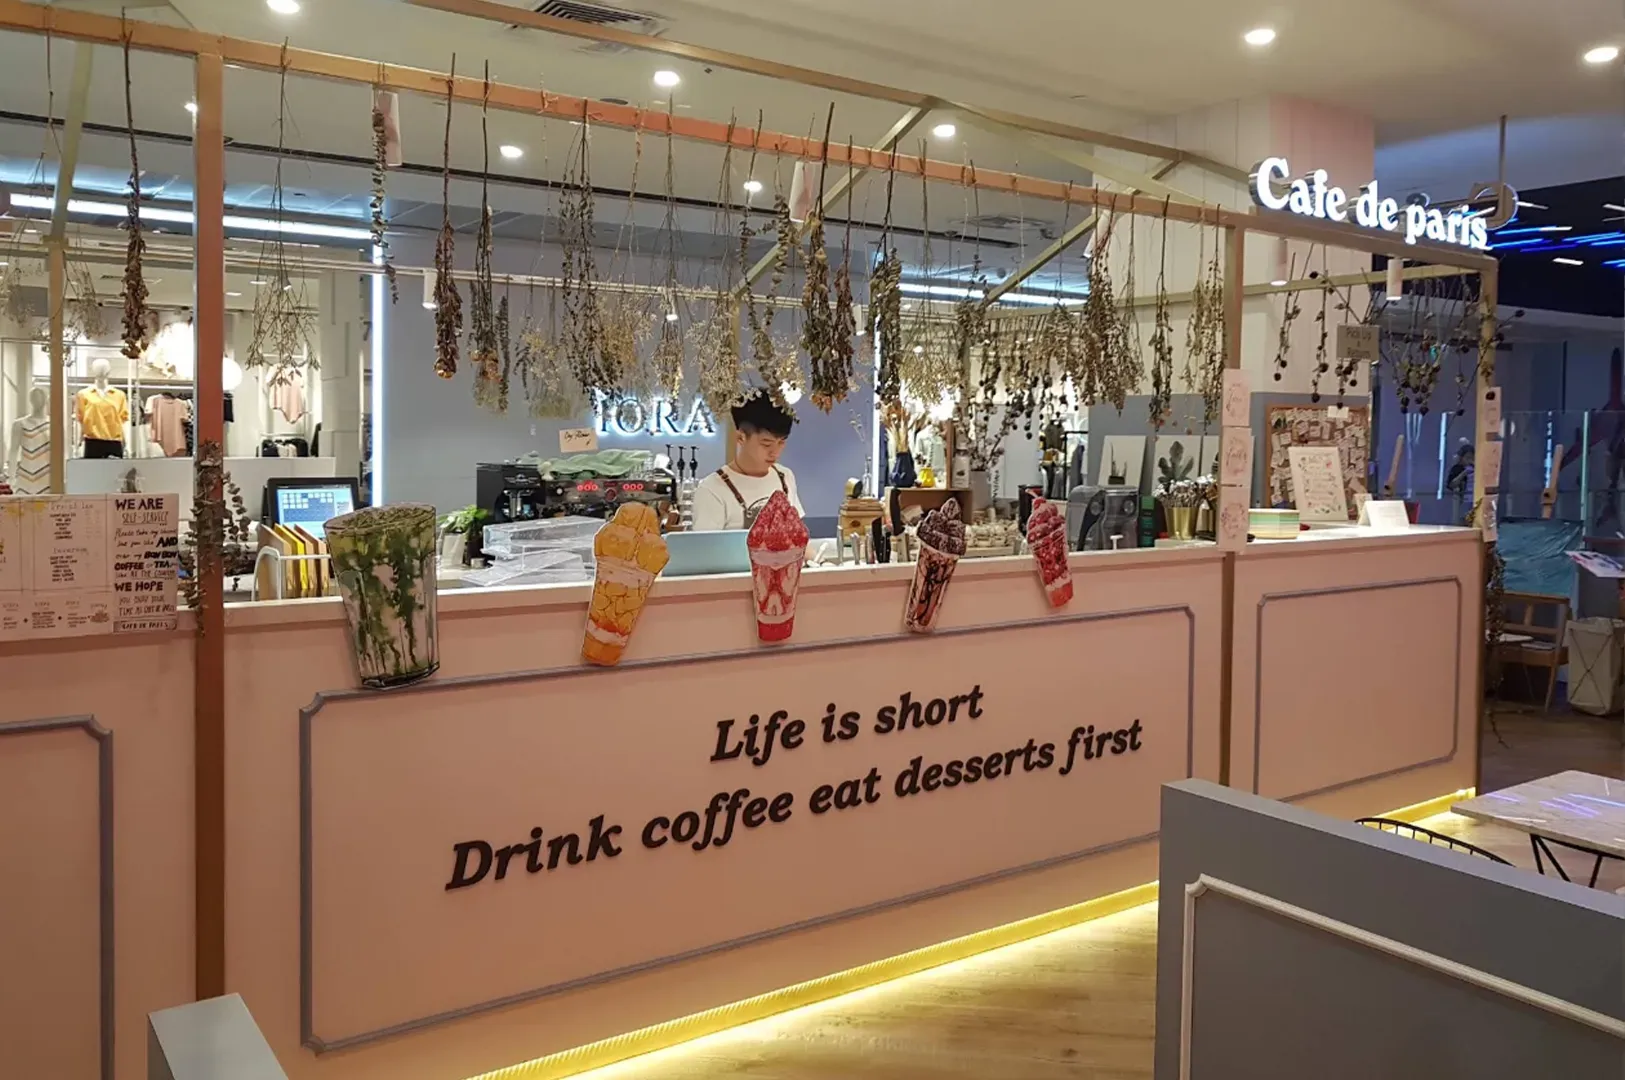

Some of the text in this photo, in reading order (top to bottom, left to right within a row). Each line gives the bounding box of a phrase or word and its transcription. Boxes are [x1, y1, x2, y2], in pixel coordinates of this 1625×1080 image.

[1253, 157, 1493, 250] Cafe de paris
[115, 498, 164, 510] WE ARE
[155, 536, 179, 547] AND
[114, 562, 144, 570] COFFEE
[114, 581, 164, 592] WE HOPE
[710, 684, 984, 766] Life is short
[444, 718, 1143, 892] Drink coffee eat desserts first
